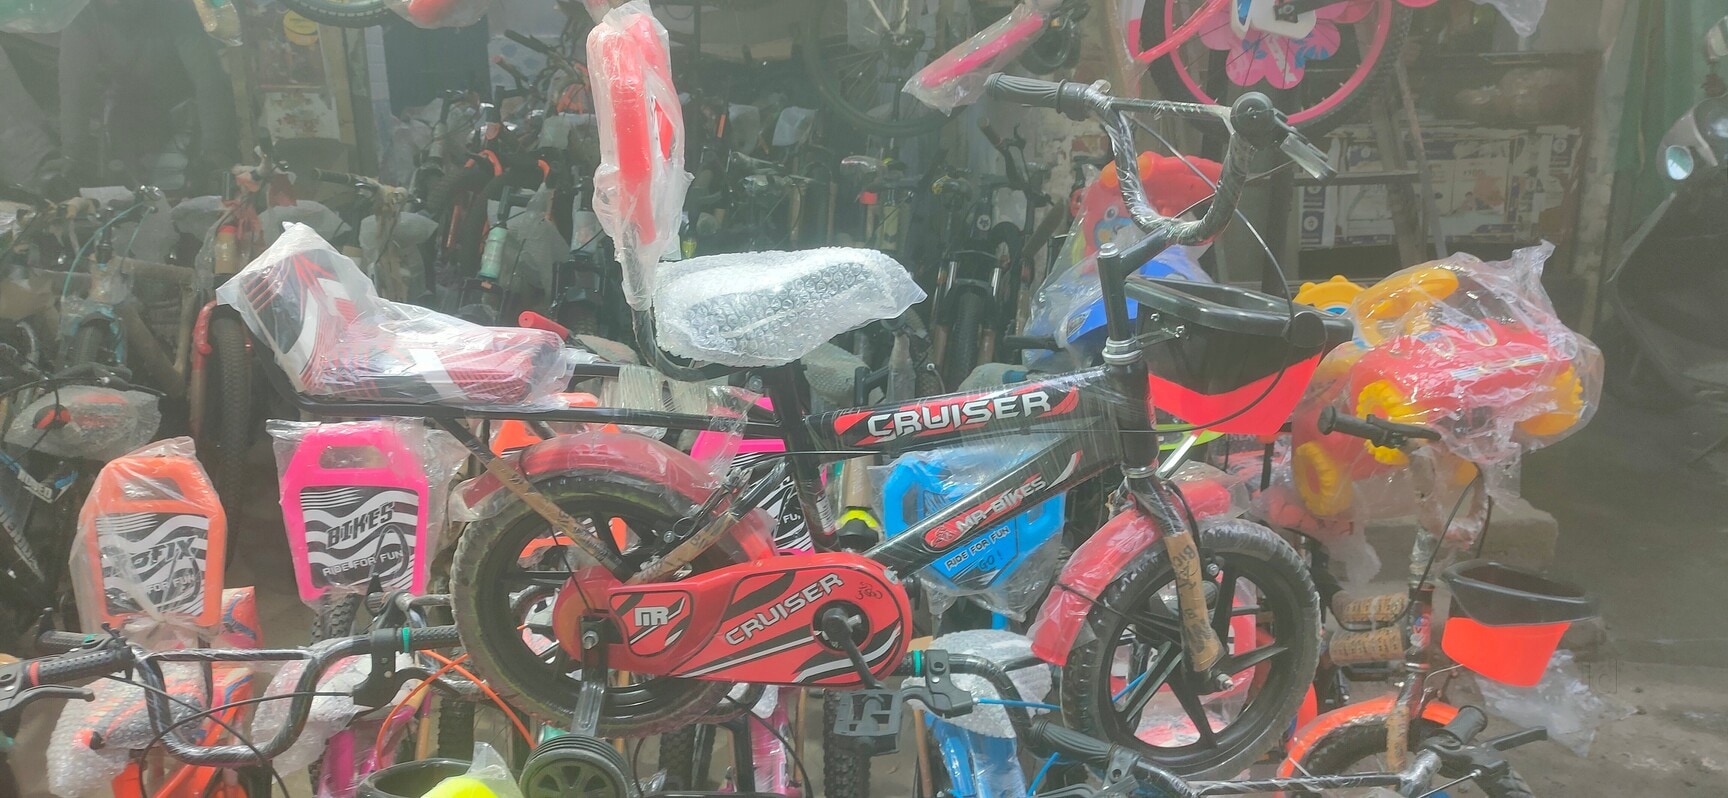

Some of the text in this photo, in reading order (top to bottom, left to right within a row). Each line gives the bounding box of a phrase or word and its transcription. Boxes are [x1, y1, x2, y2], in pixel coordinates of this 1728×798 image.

[867, 391, 1051, 438] CRUISER
[325, 501, 395, 550] BIKES
[956, 479, 1046, 531] MR-BIKES
[321, 549, 404, 578] RIDE FOR FUN
[946, 526, 1010, 570] RIDE FOR FUN
[979, 556, 995, 570] GO
[724, 572, 844, 645] CRUISER
